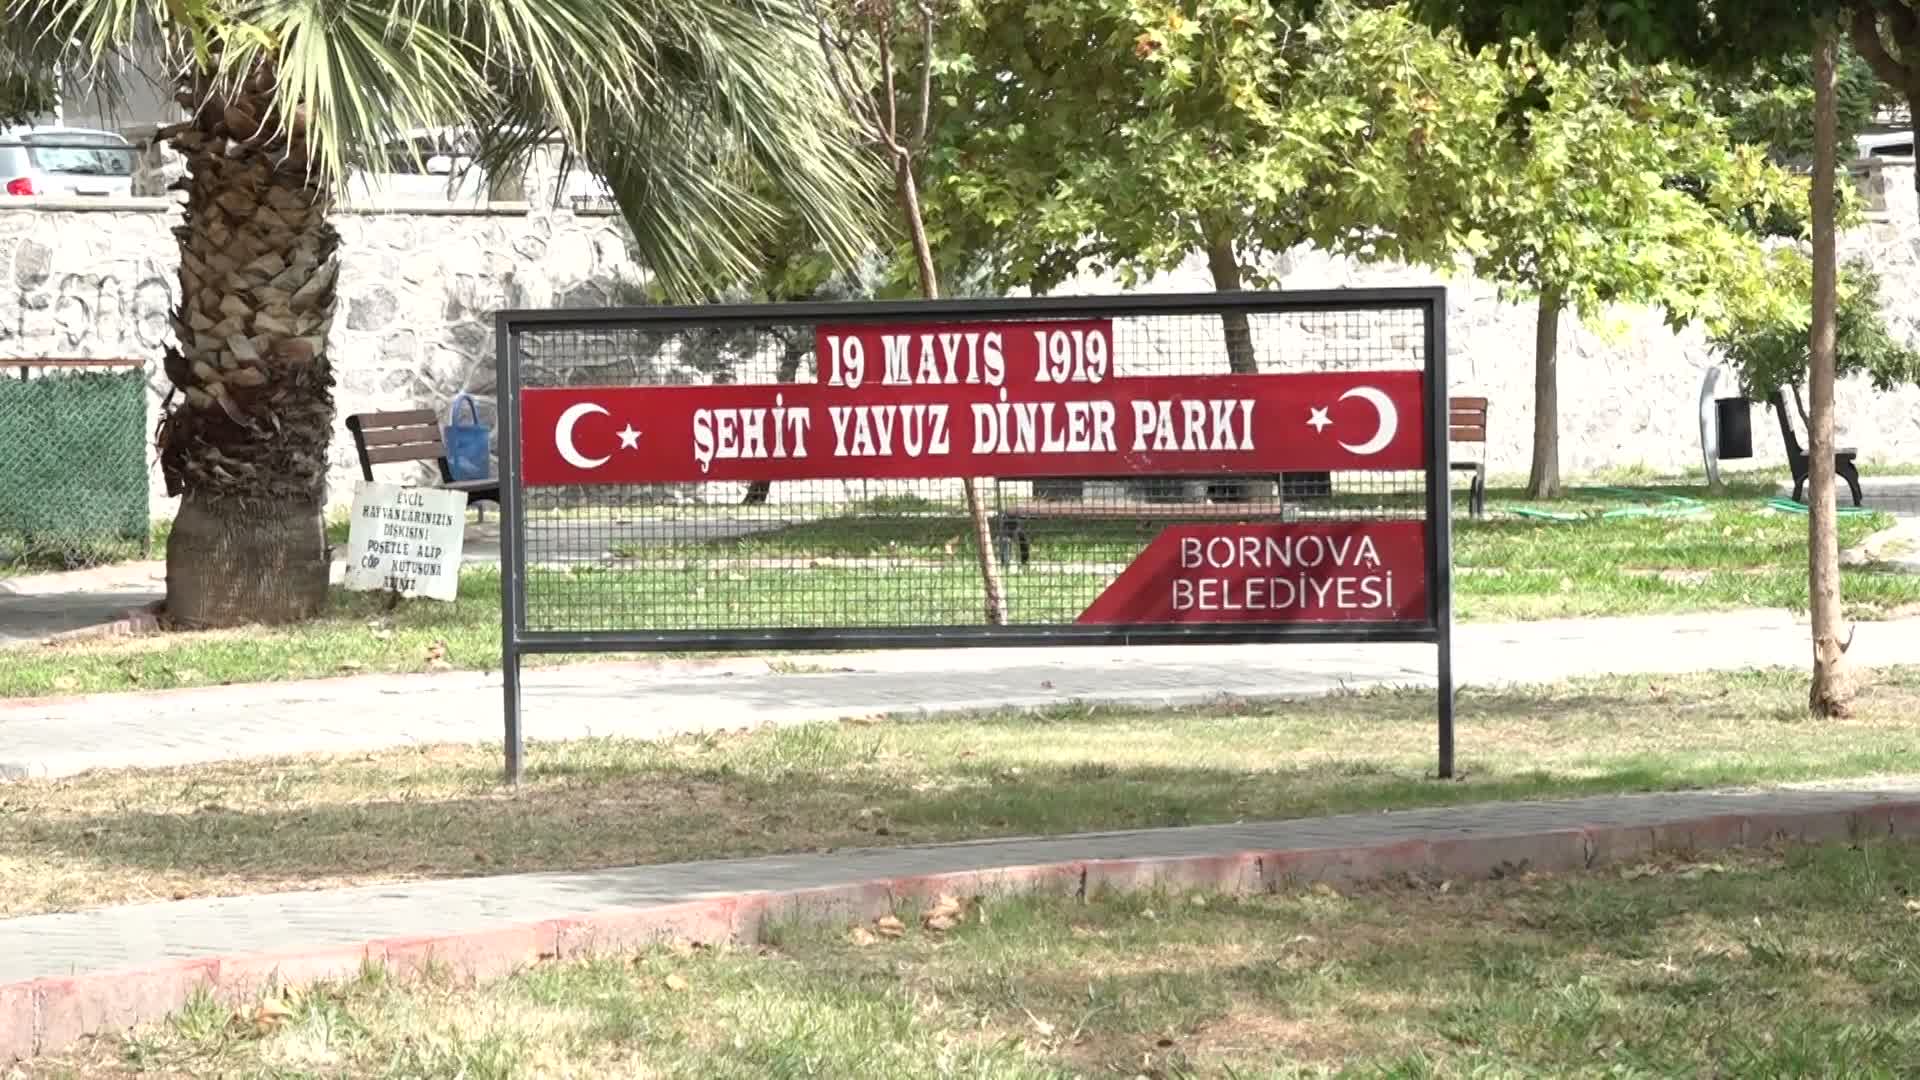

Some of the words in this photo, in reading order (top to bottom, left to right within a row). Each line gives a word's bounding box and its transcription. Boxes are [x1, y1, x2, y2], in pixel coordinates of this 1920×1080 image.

[827, 335, 864, 388] 19
[880, 331, 1005, 386] MAYIS
[1033, 330, 1107, 383] 1919
[694, 393, 810, 473] ŞEHİT
[828, 404, 949, 457] YAVUZ
[970, 387, 1117, 453] DİNLER
[1131, 399, 1255, 451] PARKI
[1181, 535, 1381, 568] BORNOVA
[1172, 570, 1394, 610] BELEDİYESİ
